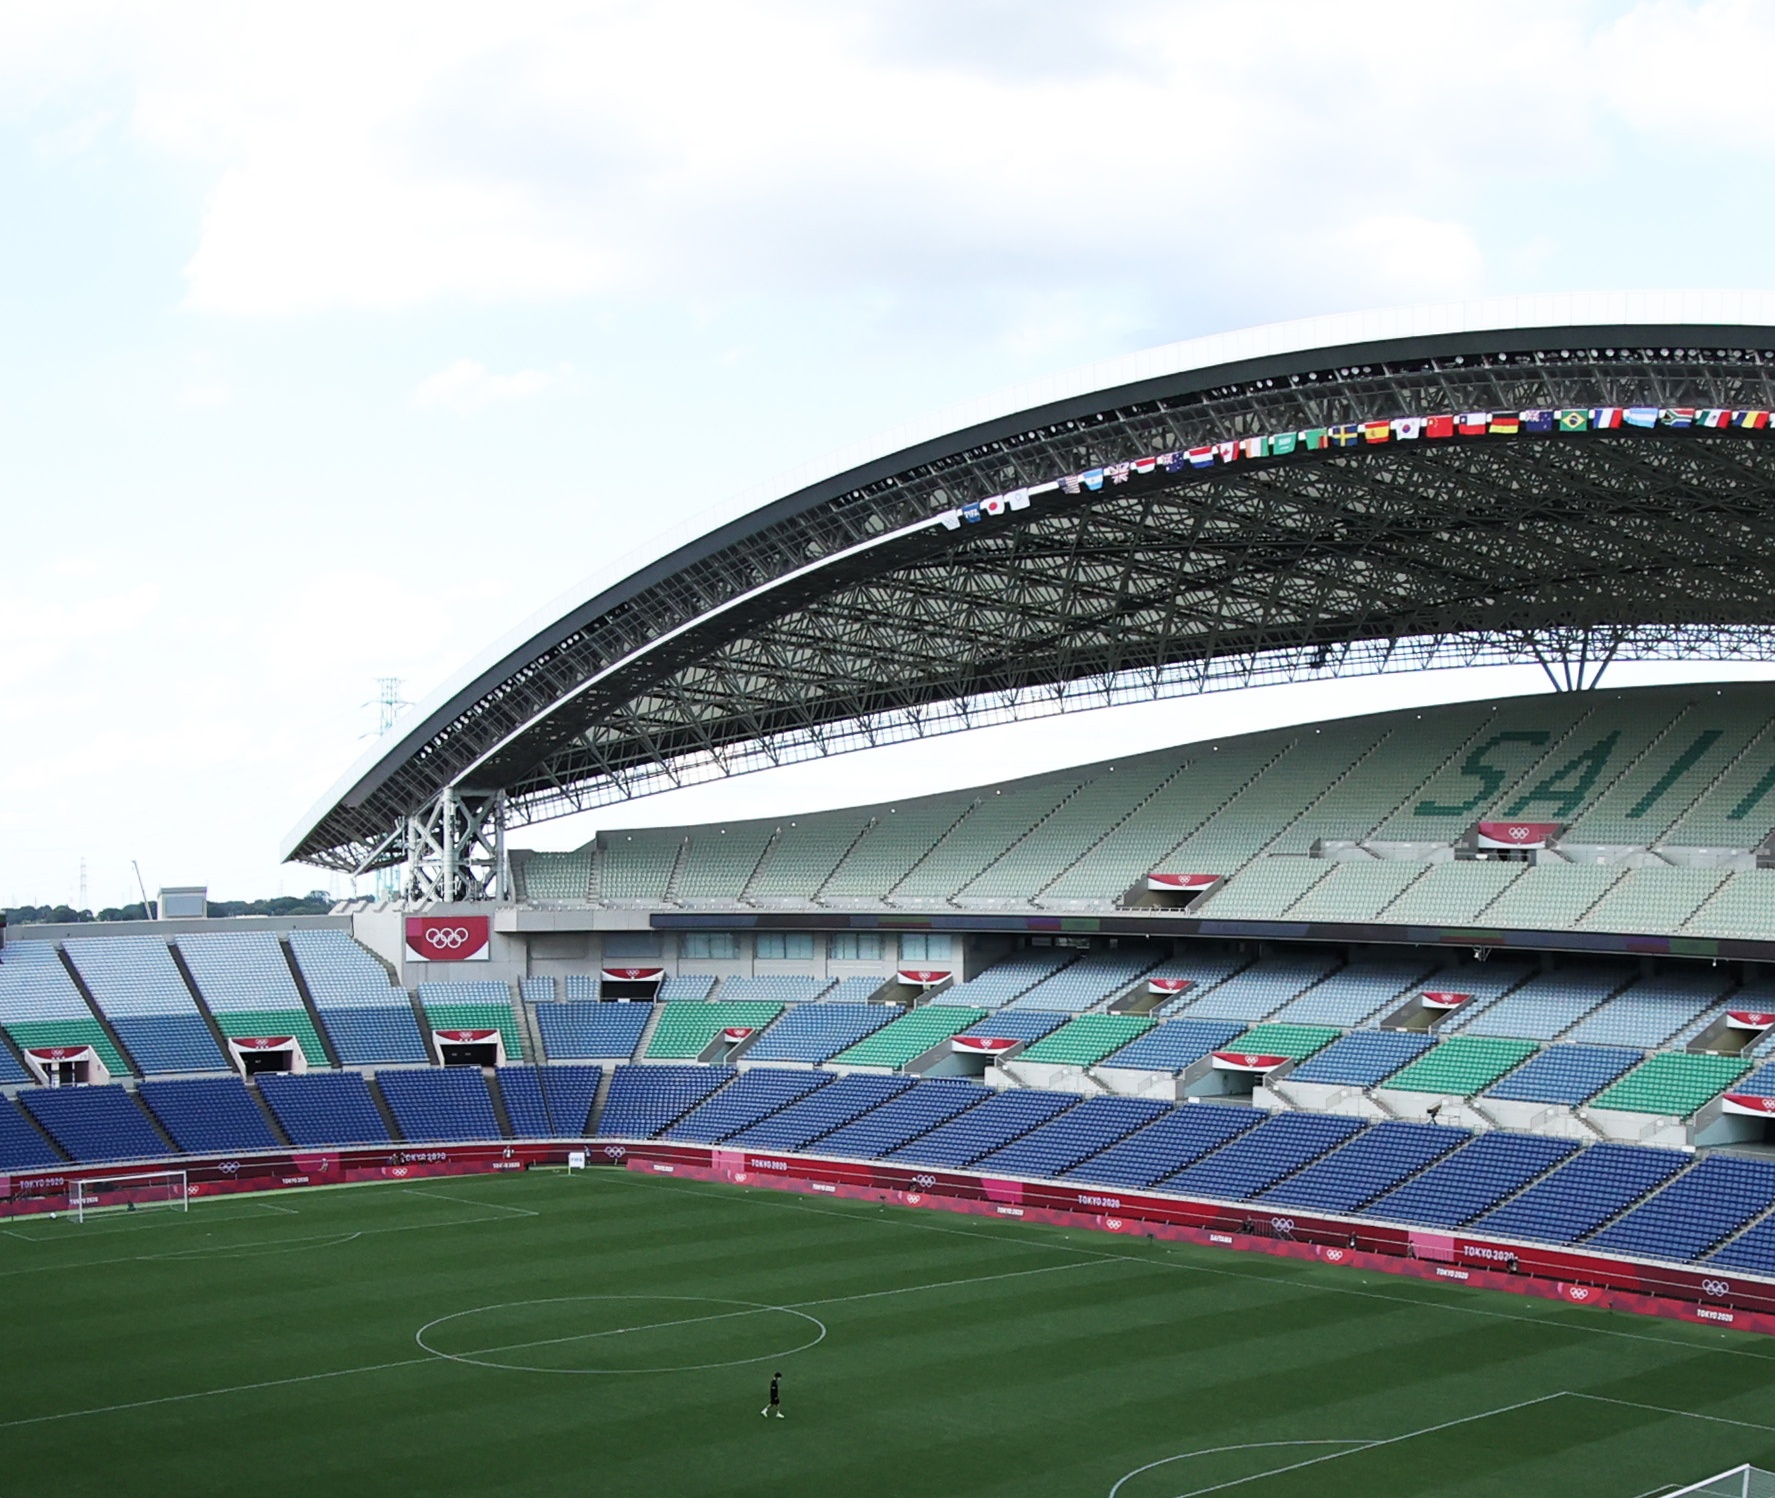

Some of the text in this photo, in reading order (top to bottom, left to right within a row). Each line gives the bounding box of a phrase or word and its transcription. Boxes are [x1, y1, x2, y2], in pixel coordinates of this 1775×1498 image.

[1078, 1194, 1121, 1209] TOKYO 2020
[1463, 1245, 1492, 1259] TOKYO
